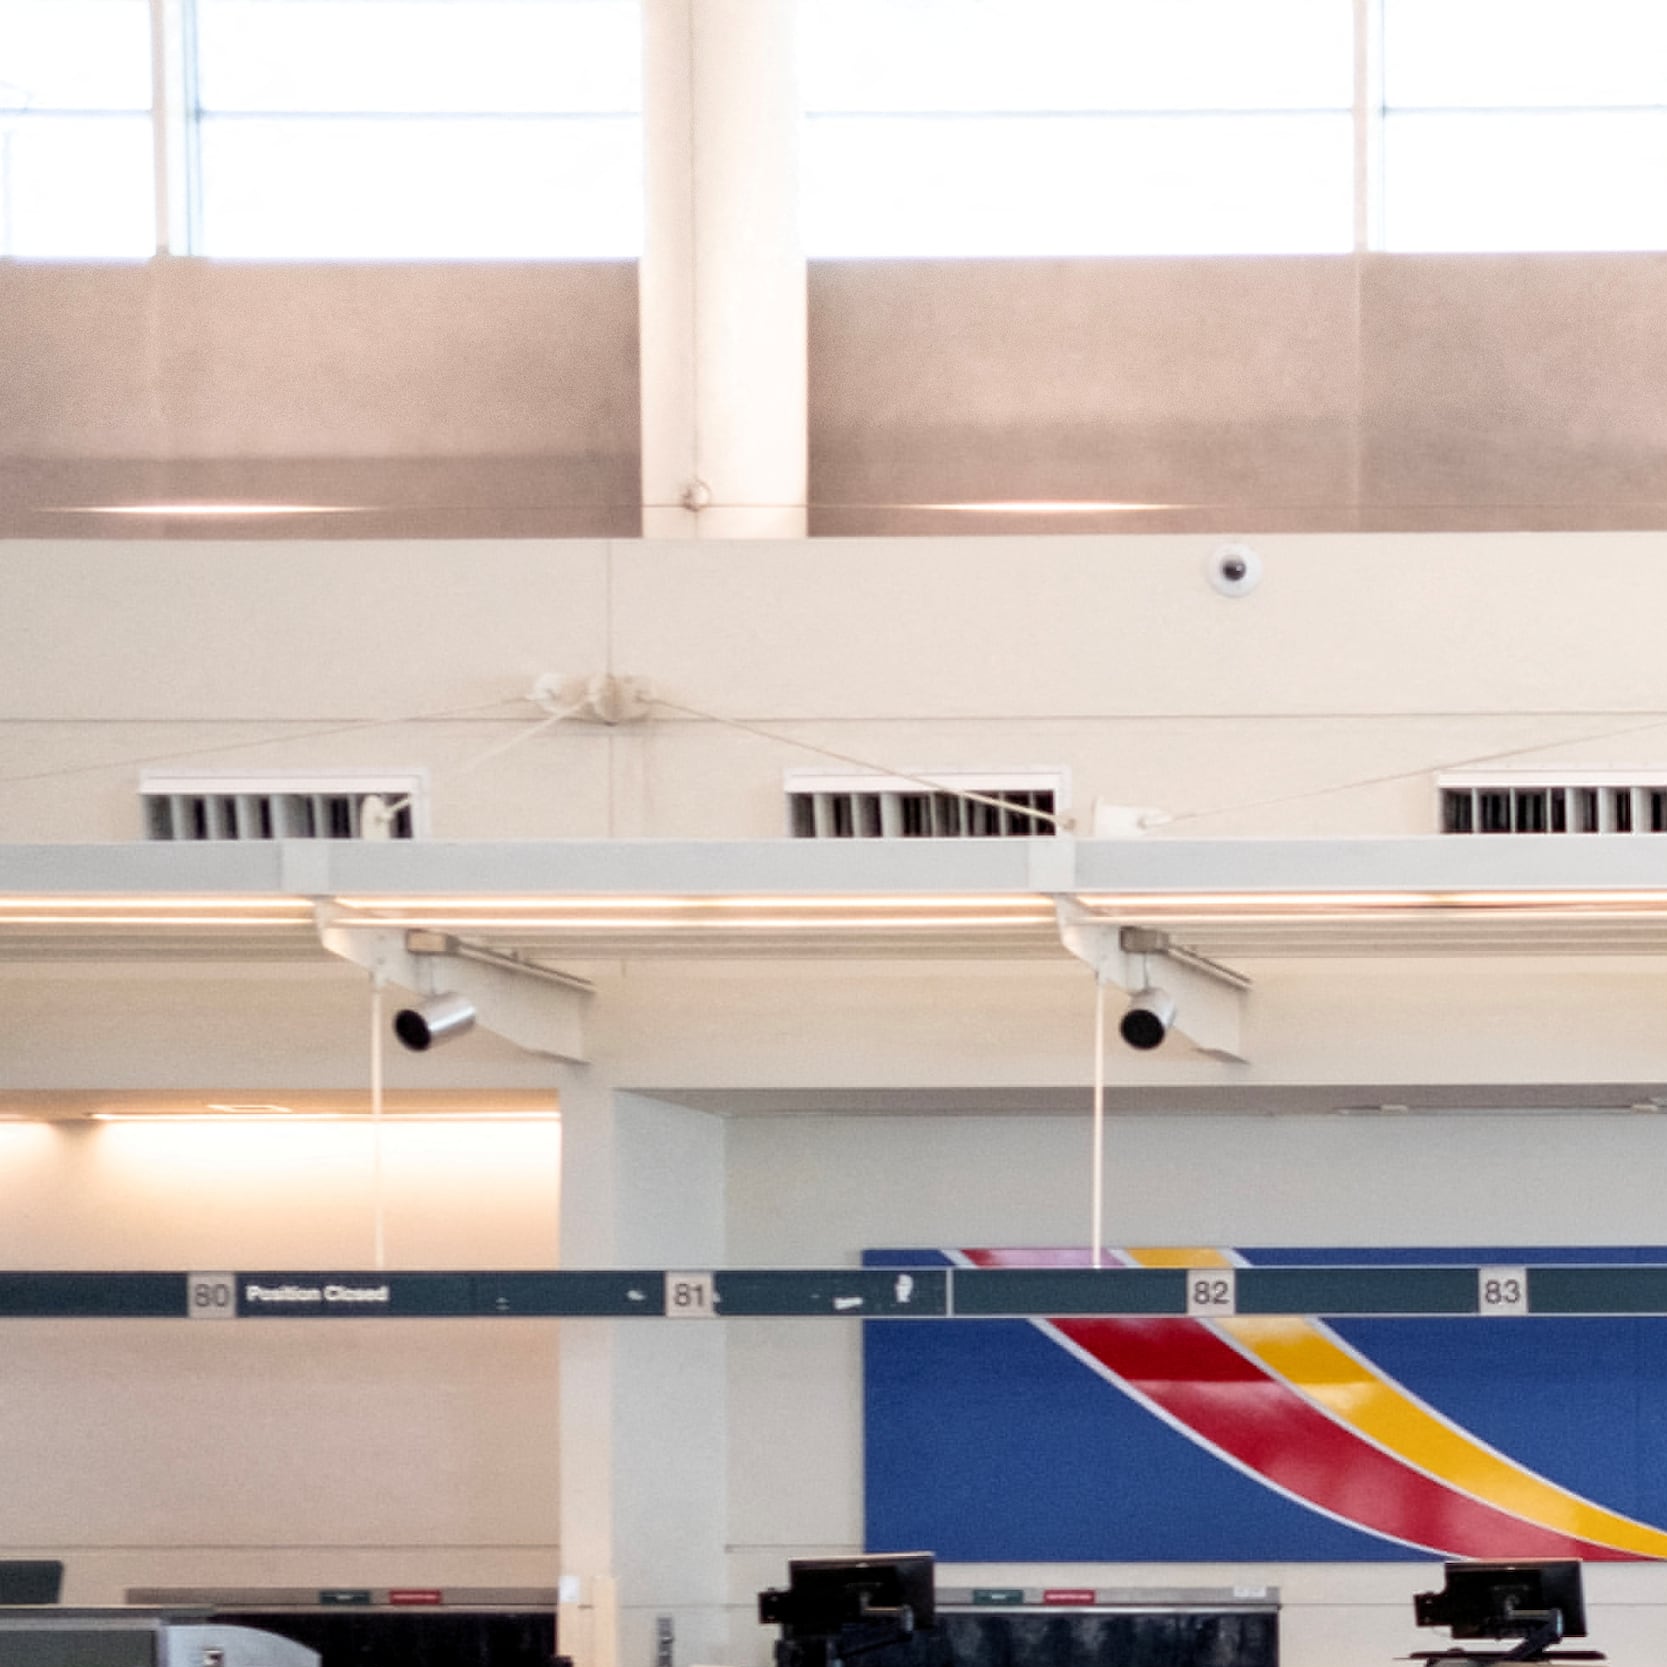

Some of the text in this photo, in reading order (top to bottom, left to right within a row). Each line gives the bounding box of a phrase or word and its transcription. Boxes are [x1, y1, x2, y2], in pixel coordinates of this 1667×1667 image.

[193, 1284, 230, 1307] 80
[246, 1285, 389, 1301] Position Closed
[674, 1284, 704, 1307] 81
[1193, 1281, 1229, 1304] 82
[1485, 1280, 1520, 1304] 83
